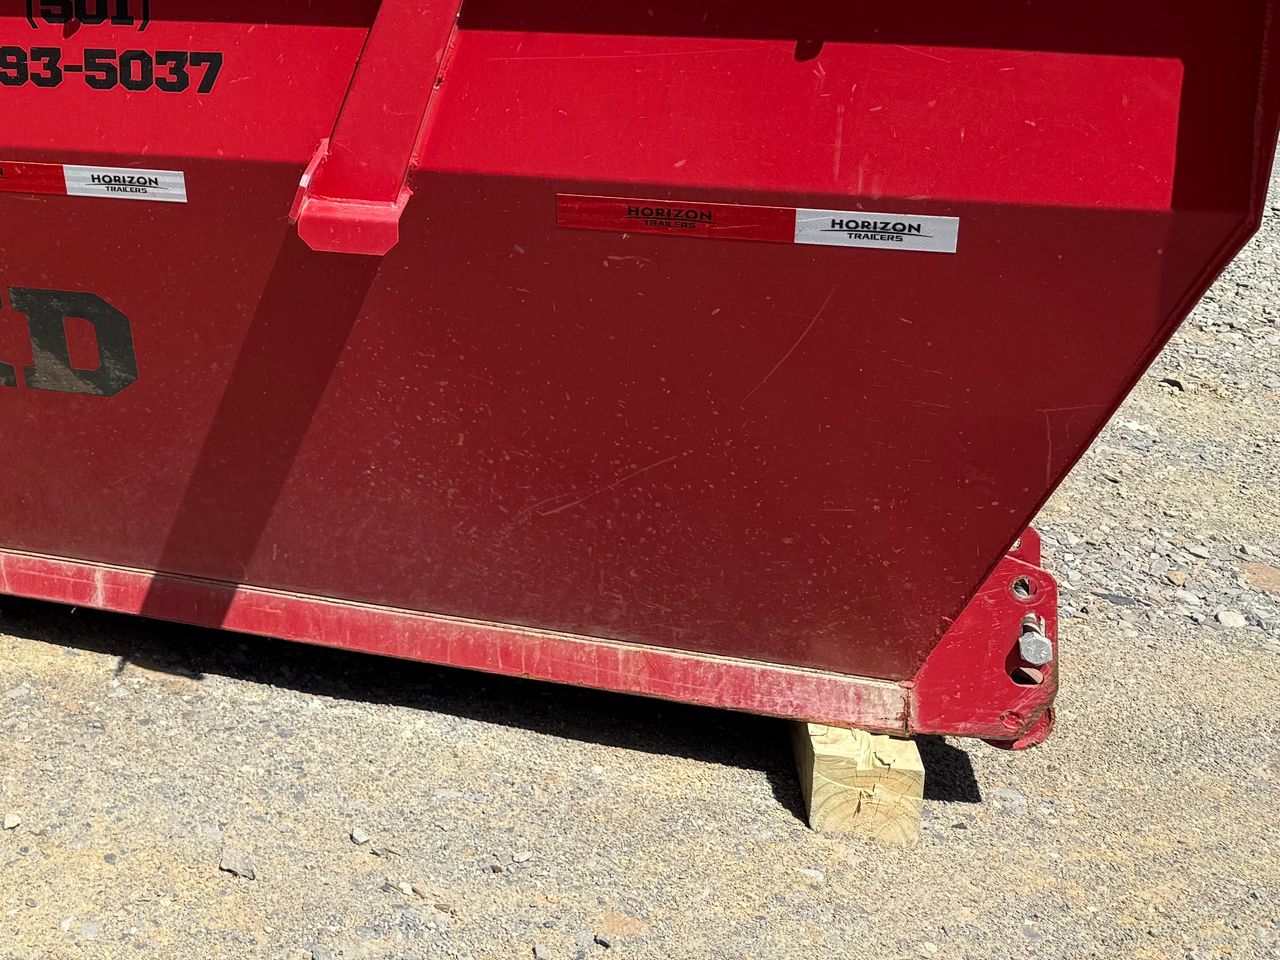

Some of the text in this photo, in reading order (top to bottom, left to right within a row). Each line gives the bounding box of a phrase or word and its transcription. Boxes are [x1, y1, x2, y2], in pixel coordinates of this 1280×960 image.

[90, 173, 160, 187] HORIZON
[105, 185, 148, 194] TRAILERS
[626, 205, 713, 221] HORIZON
[643, 219, 697, 229] TRAILERS
[830, 218, 922, 234] HORIZON
[846, 232, 904, 242] TRAILERS
